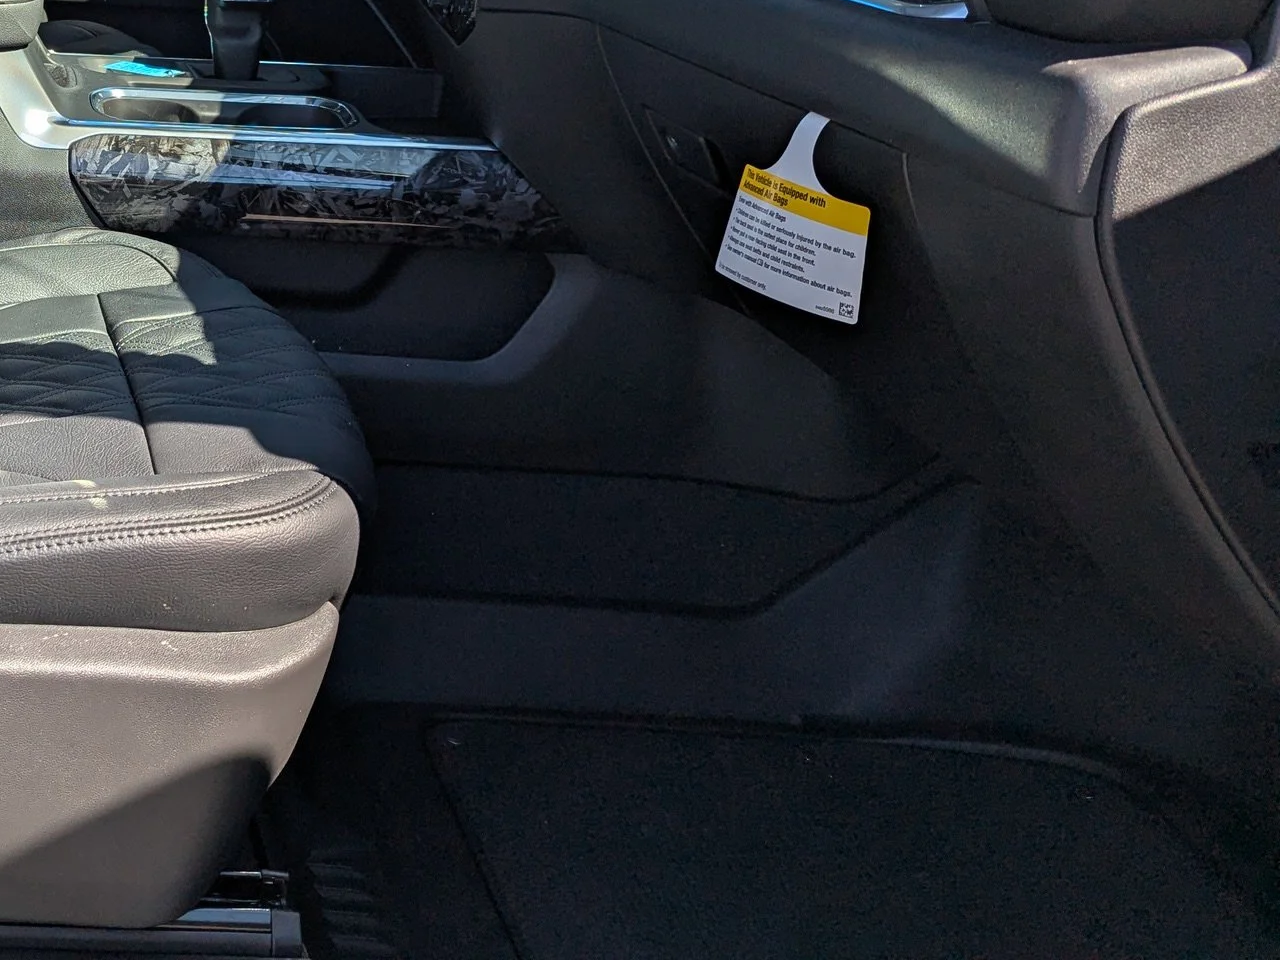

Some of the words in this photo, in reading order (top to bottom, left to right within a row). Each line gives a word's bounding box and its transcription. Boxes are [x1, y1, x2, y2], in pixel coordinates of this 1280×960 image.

[744, 180, 764, 196] Advanced
[764, 189, 773, 200] Air
[773, 193, 789, 207] Bags
[756, 172, 772, 187] Vehicle
[779, 183, 809, 202] Equipped
[810, 194, 826, 208] with
[775, 212, 787, 223] Bags
[776, 227, 796, 239] seriously
[796, 233, 814, 245] injured
[815, 239, 821, 248] by
[822, 243, 832, 251] the
[842, 249, 856, 258] bag.
[770, 266, 781, 274] more
[782, 269, 810, 284] information
[810, 280, 826, 291] about
[827, 285, 835, 293] air
[836, 287, 853, 298] bags.
